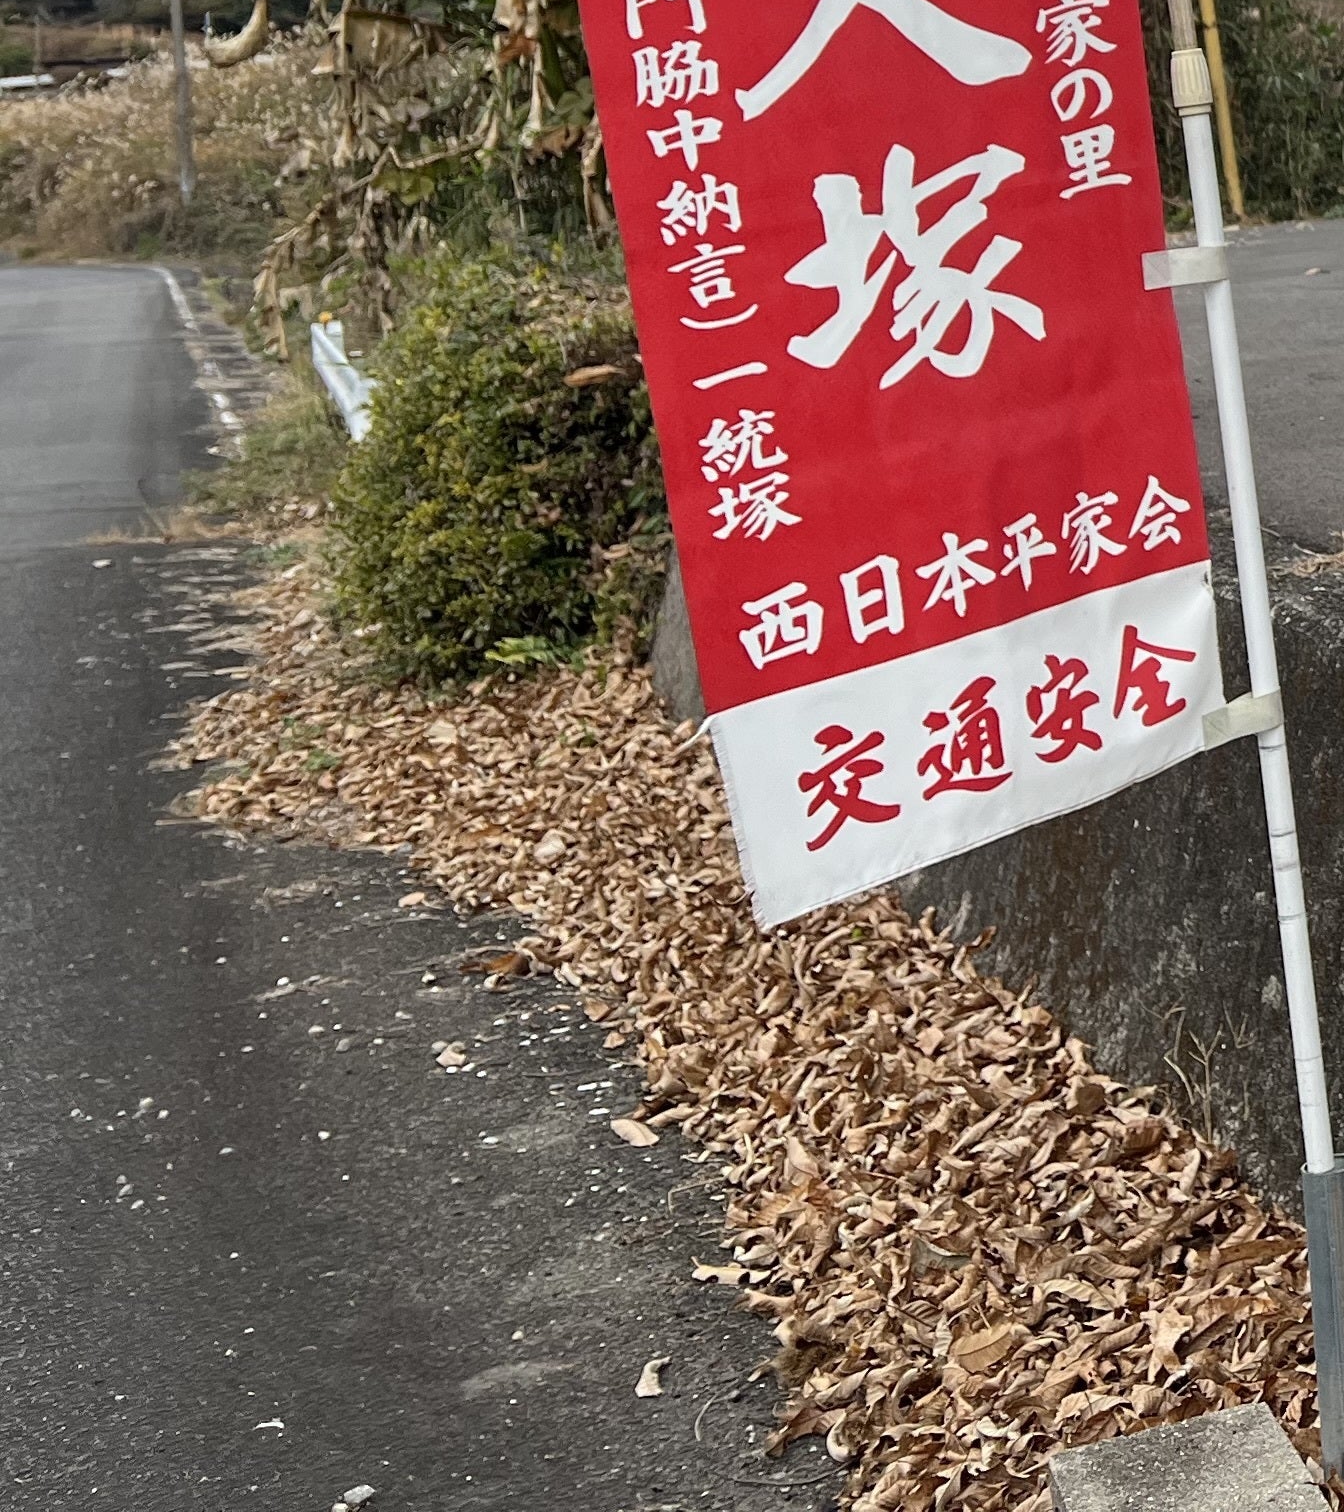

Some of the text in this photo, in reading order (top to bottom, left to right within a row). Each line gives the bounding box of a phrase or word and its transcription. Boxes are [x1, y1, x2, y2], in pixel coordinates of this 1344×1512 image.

[740, 476, 1190, 669] 西日本平家会
[798, 625, 1196, 851] 交通安全
